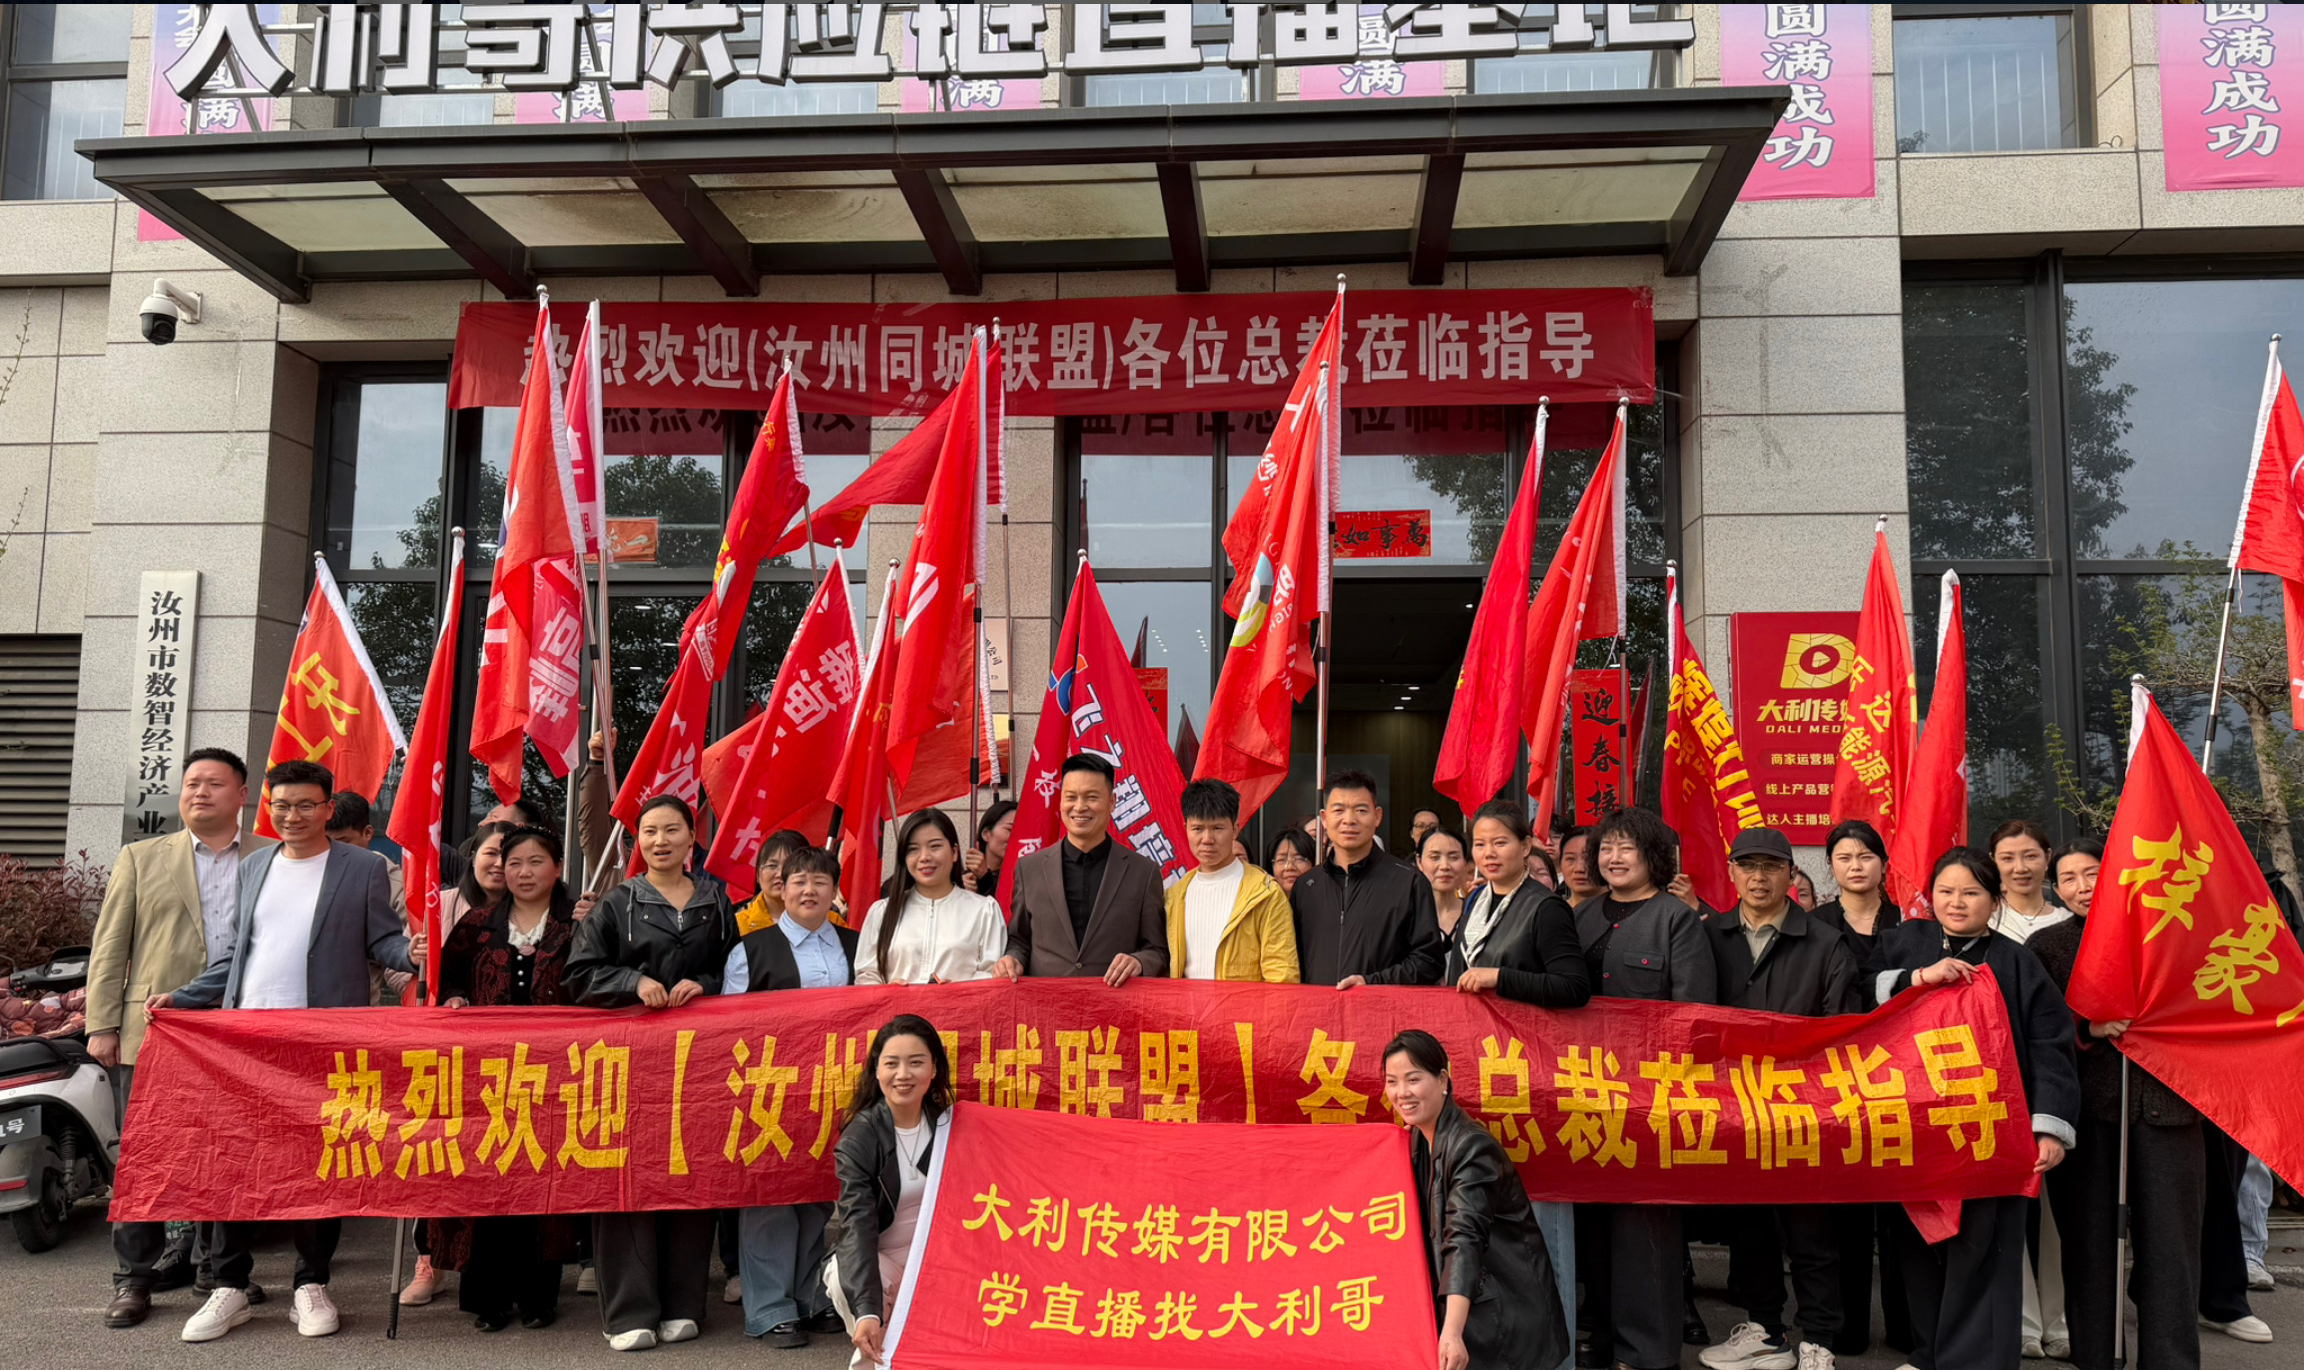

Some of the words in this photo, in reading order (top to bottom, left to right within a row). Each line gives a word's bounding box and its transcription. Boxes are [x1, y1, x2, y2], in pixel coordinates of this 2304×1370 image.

[134, 591, 184, 843] 汝州市数智经济产业
[1809, 725, 1845, 734] MED
[1770, 753, 1840, 767] 商家运营操
[1766, 813, 1834, 827] 达人主播培
[316, 1021, 2008, 1181] 热烈欢迎【汝州城联盟】各总裁莅临指导
[961, 1183, 1408, 1265] 大利传媒有限公司
[977, 1271, 1386, 1341] 学直播找大利哥
